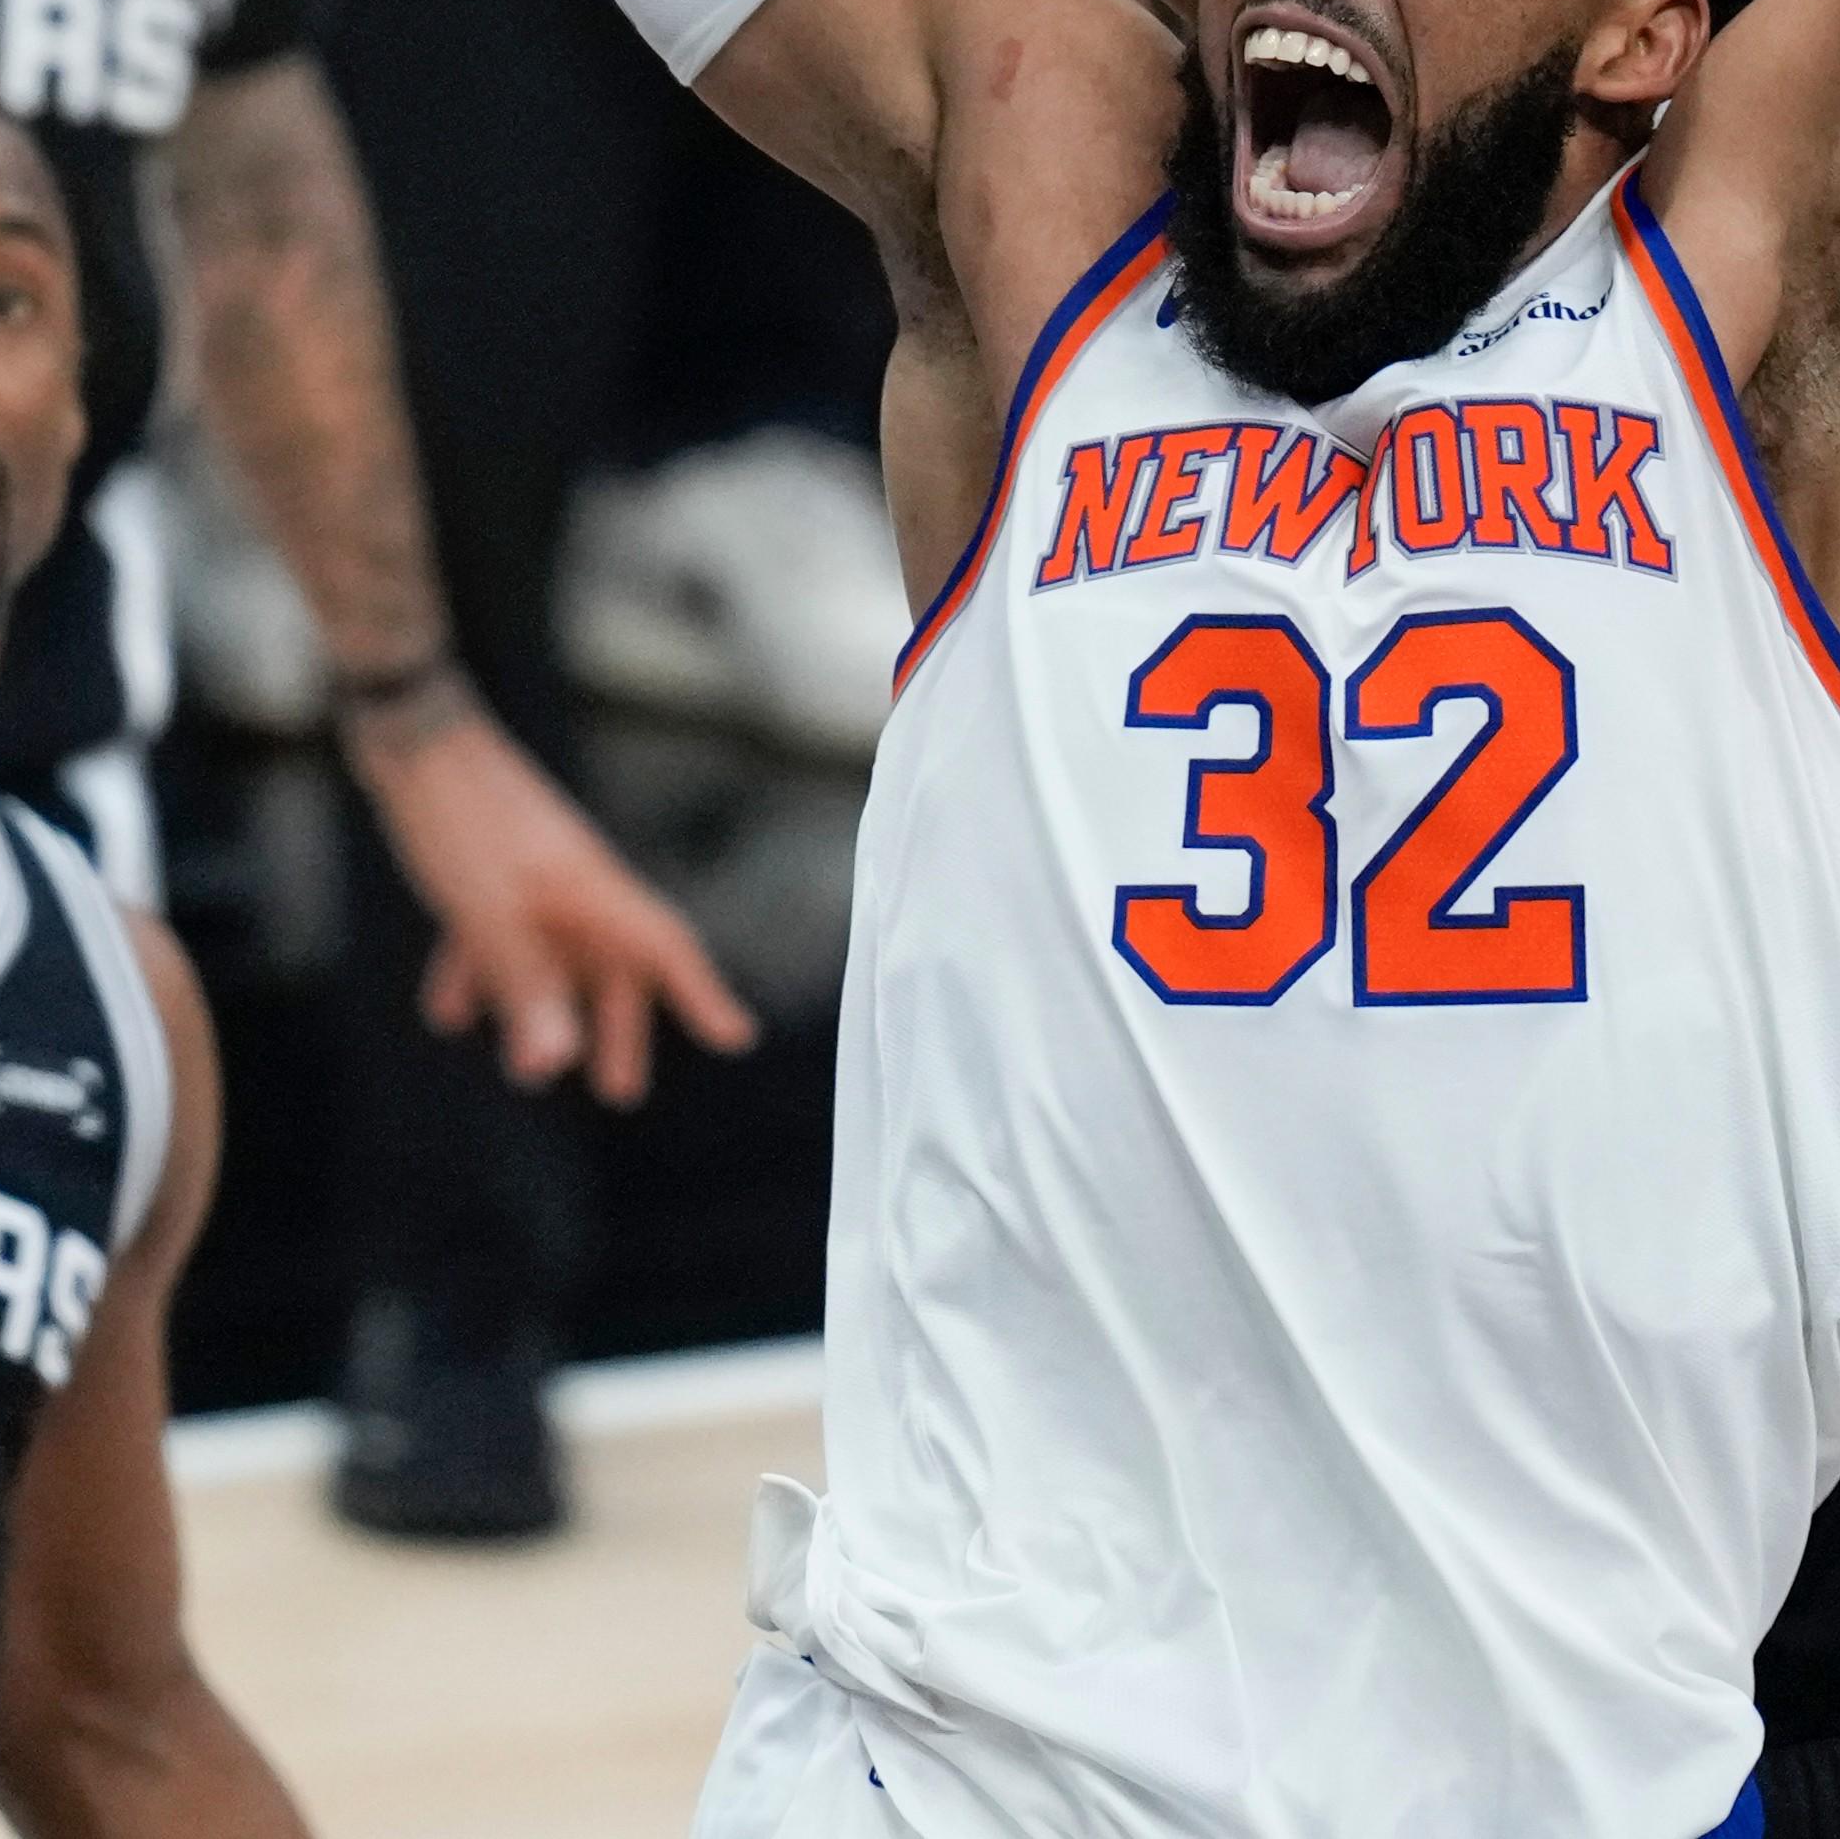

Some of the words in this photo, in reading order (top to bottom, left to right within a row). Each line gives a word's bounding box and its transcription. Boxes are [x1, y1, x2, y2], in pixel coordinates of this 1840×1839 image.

[1029, 418, 1373, 596] NEW
[1343, 394, 1679, 589] YORK
[1111, 606, 1589, 1008] 32
